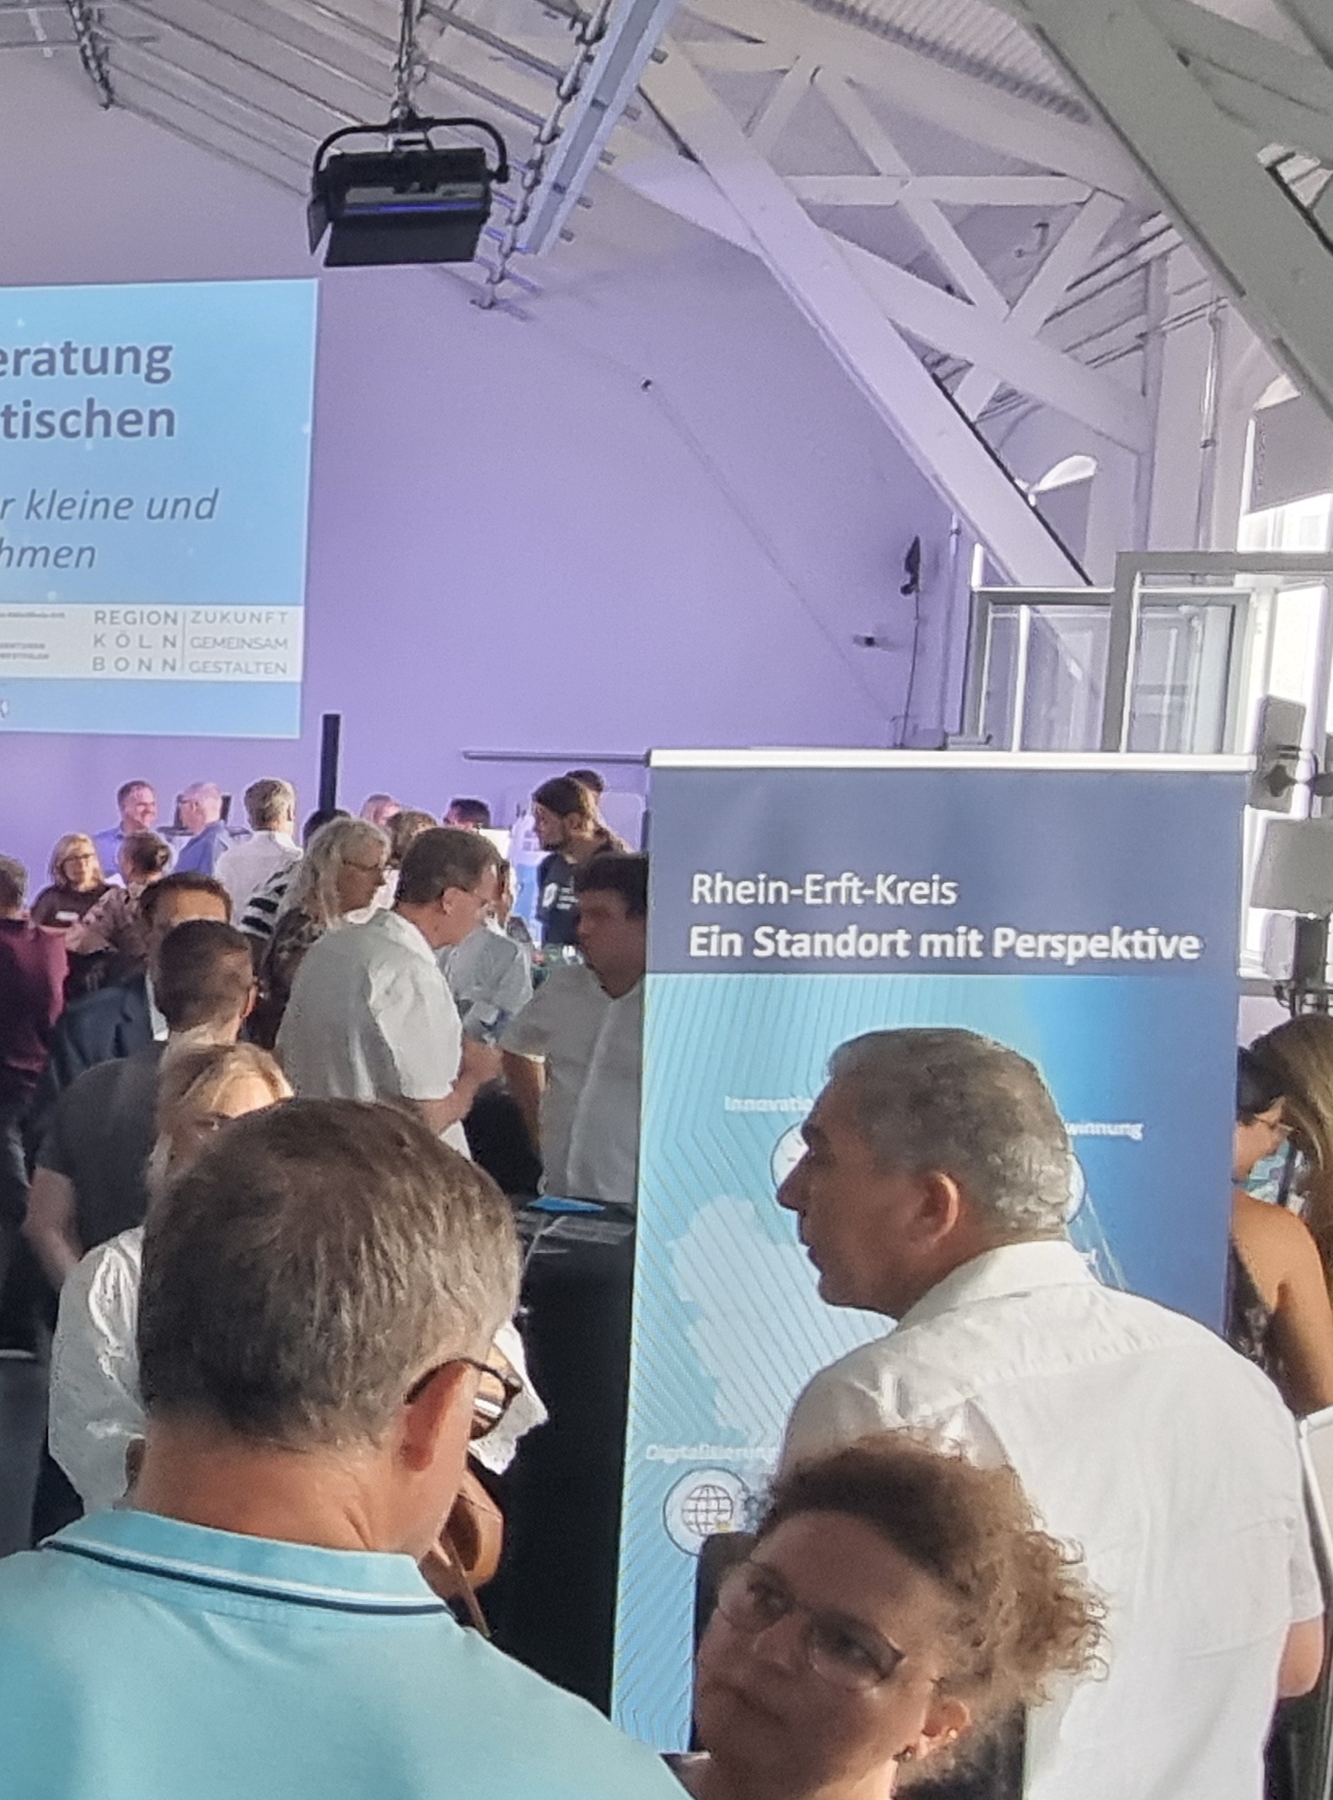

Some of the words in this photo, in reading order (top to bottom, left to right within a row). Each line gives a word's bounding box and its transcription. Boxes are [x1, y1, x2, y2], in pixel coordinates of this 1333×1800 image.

[24, 487, 134, 520] kleine
[145, 487, 220, 520] und
[93, 610, 178, 626] REGION
[190, 610, 289, 625] ZUKUNFT
[93, 631, 178, 649] KÖLN
[190, 636, 289, 650] GEMEINSAM
[92, 656, 177, 673] BONN
[188, 660, 288, 675] GESTALTEN
[690, 871, 959, 906] Rhein-Erft-Kreis
[689, 924, 743, 958] Ein
[753, 924, 912, 958] Standort
[919, 925, 984, 958] mit
[993, 925, 1203, 966] Perspektive
[724, 1095, 815, 1112] Innovatio
